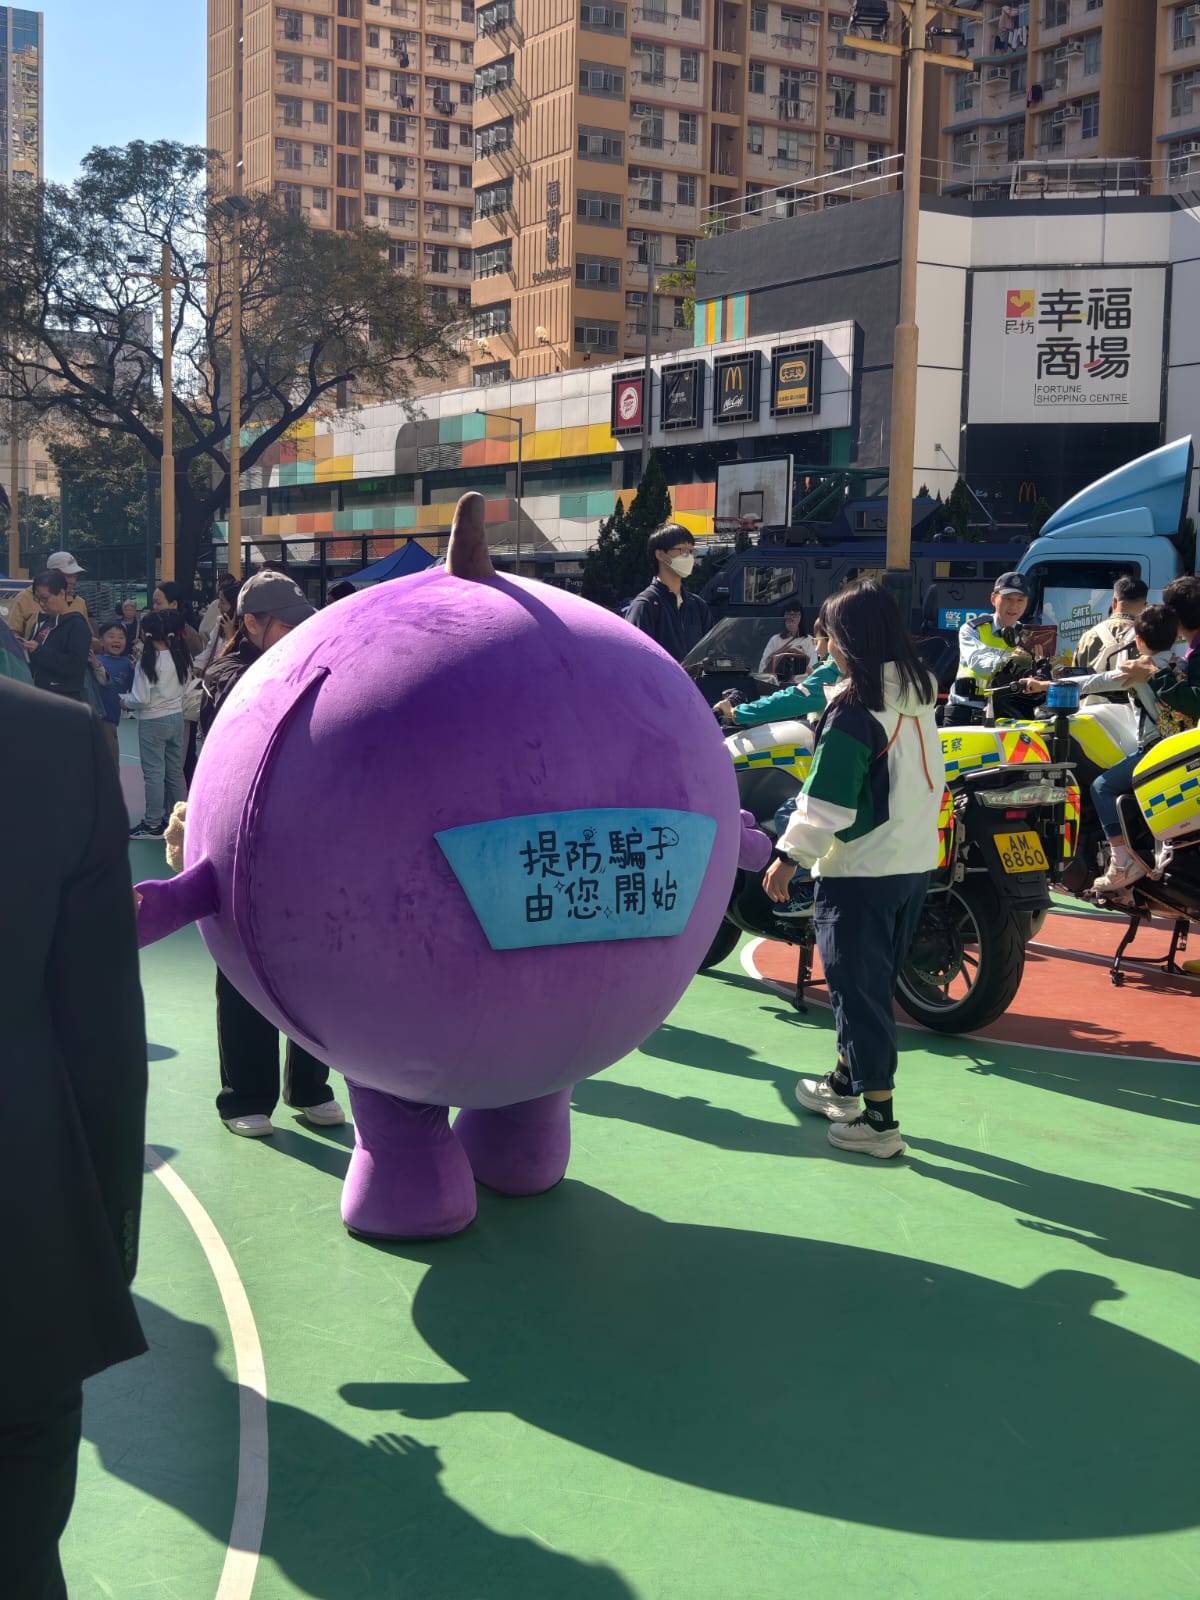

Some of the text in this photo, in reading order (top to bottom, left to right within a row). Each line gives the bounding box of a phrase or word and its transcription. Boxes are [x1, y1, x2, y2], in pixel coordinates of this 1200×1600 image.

[1038, 287, 1133, 333] 幸福
[1036, 335, 1131, 380] 商場
[1037, 385, 1082, 394] FORTUNE
[1037, 393, 1128, 403] SHOPPING CENTRE
[945, 611, 961, 628] 警
[1073, 606, 1090, 618] SAFE
[1061, 614, 1102, 631] COMMUNITY
[951, 737, 963, 752] 察
[1009, 834, 1030, 851] AM
[519, 826, 672, 878] 提防騙子
[1002, 849, 1045, 869] 8860
[525, 870, 678, 923] 由您開始
